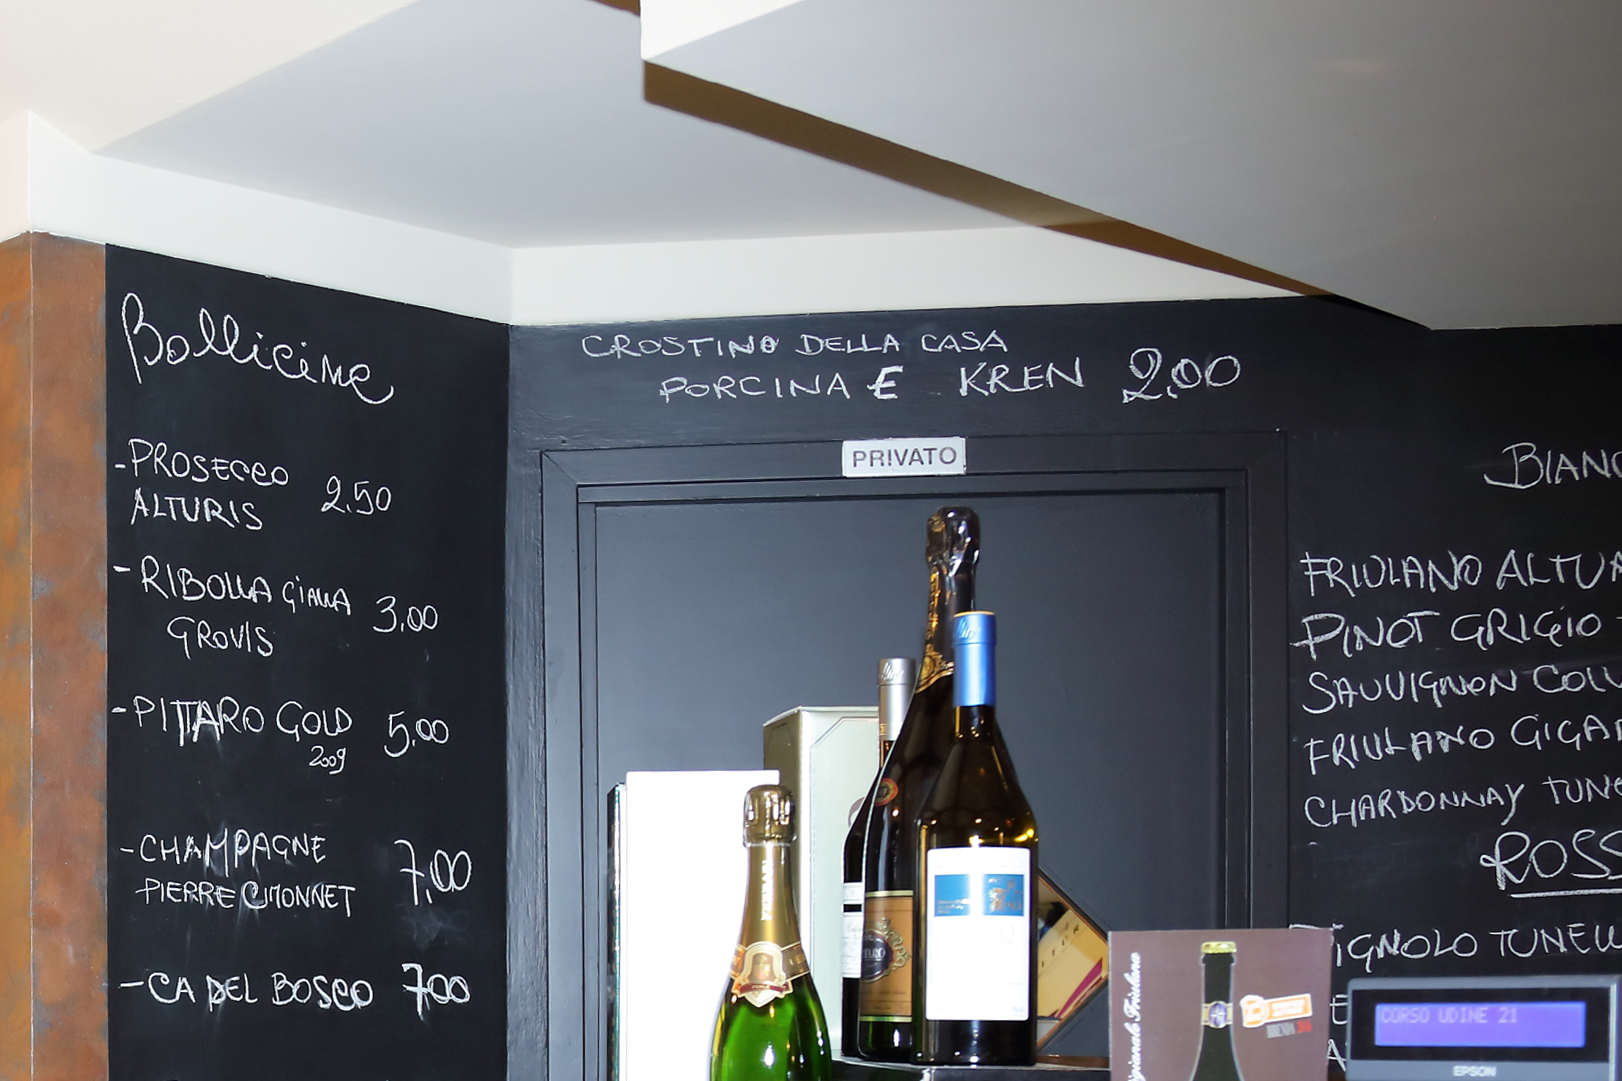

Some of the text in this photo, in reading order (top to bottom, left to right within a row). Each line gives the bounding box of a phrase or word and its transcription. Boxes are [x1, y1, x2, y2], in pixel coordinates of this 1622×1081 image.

[121, 291, 395, 405] Bollicine
[581, 329, 1009, 360] CROSTINO DELLA CASA
[659, 362, 851, 404] PORCINA
[958, 356, 1085, 399] KREN
[851, 445, 959, 470] PRIVATO
[131, 488, 264, 531] ALTURIS
[1300, 550, 1483, 598] FRIULANO
[166, 614, 275, 660] GROVIS
[1289, 609, 1441, 661] PINOT
[1302, 670, 1518, 715] SAUVIGNON
[276, 700, 353, 743] GOLD
[1303, 726, 1496, 776] FRIULANO
[1304, 782, 1526, 828] CHARDONNAY
[206, 972, 258, 1012] DEL
[271, 972, 375, 1012] BOSCO
[1381, 1005, 1518, 1024] CORSO UDINE 21
[1452, 1065, 1497, 1078] EPSON
